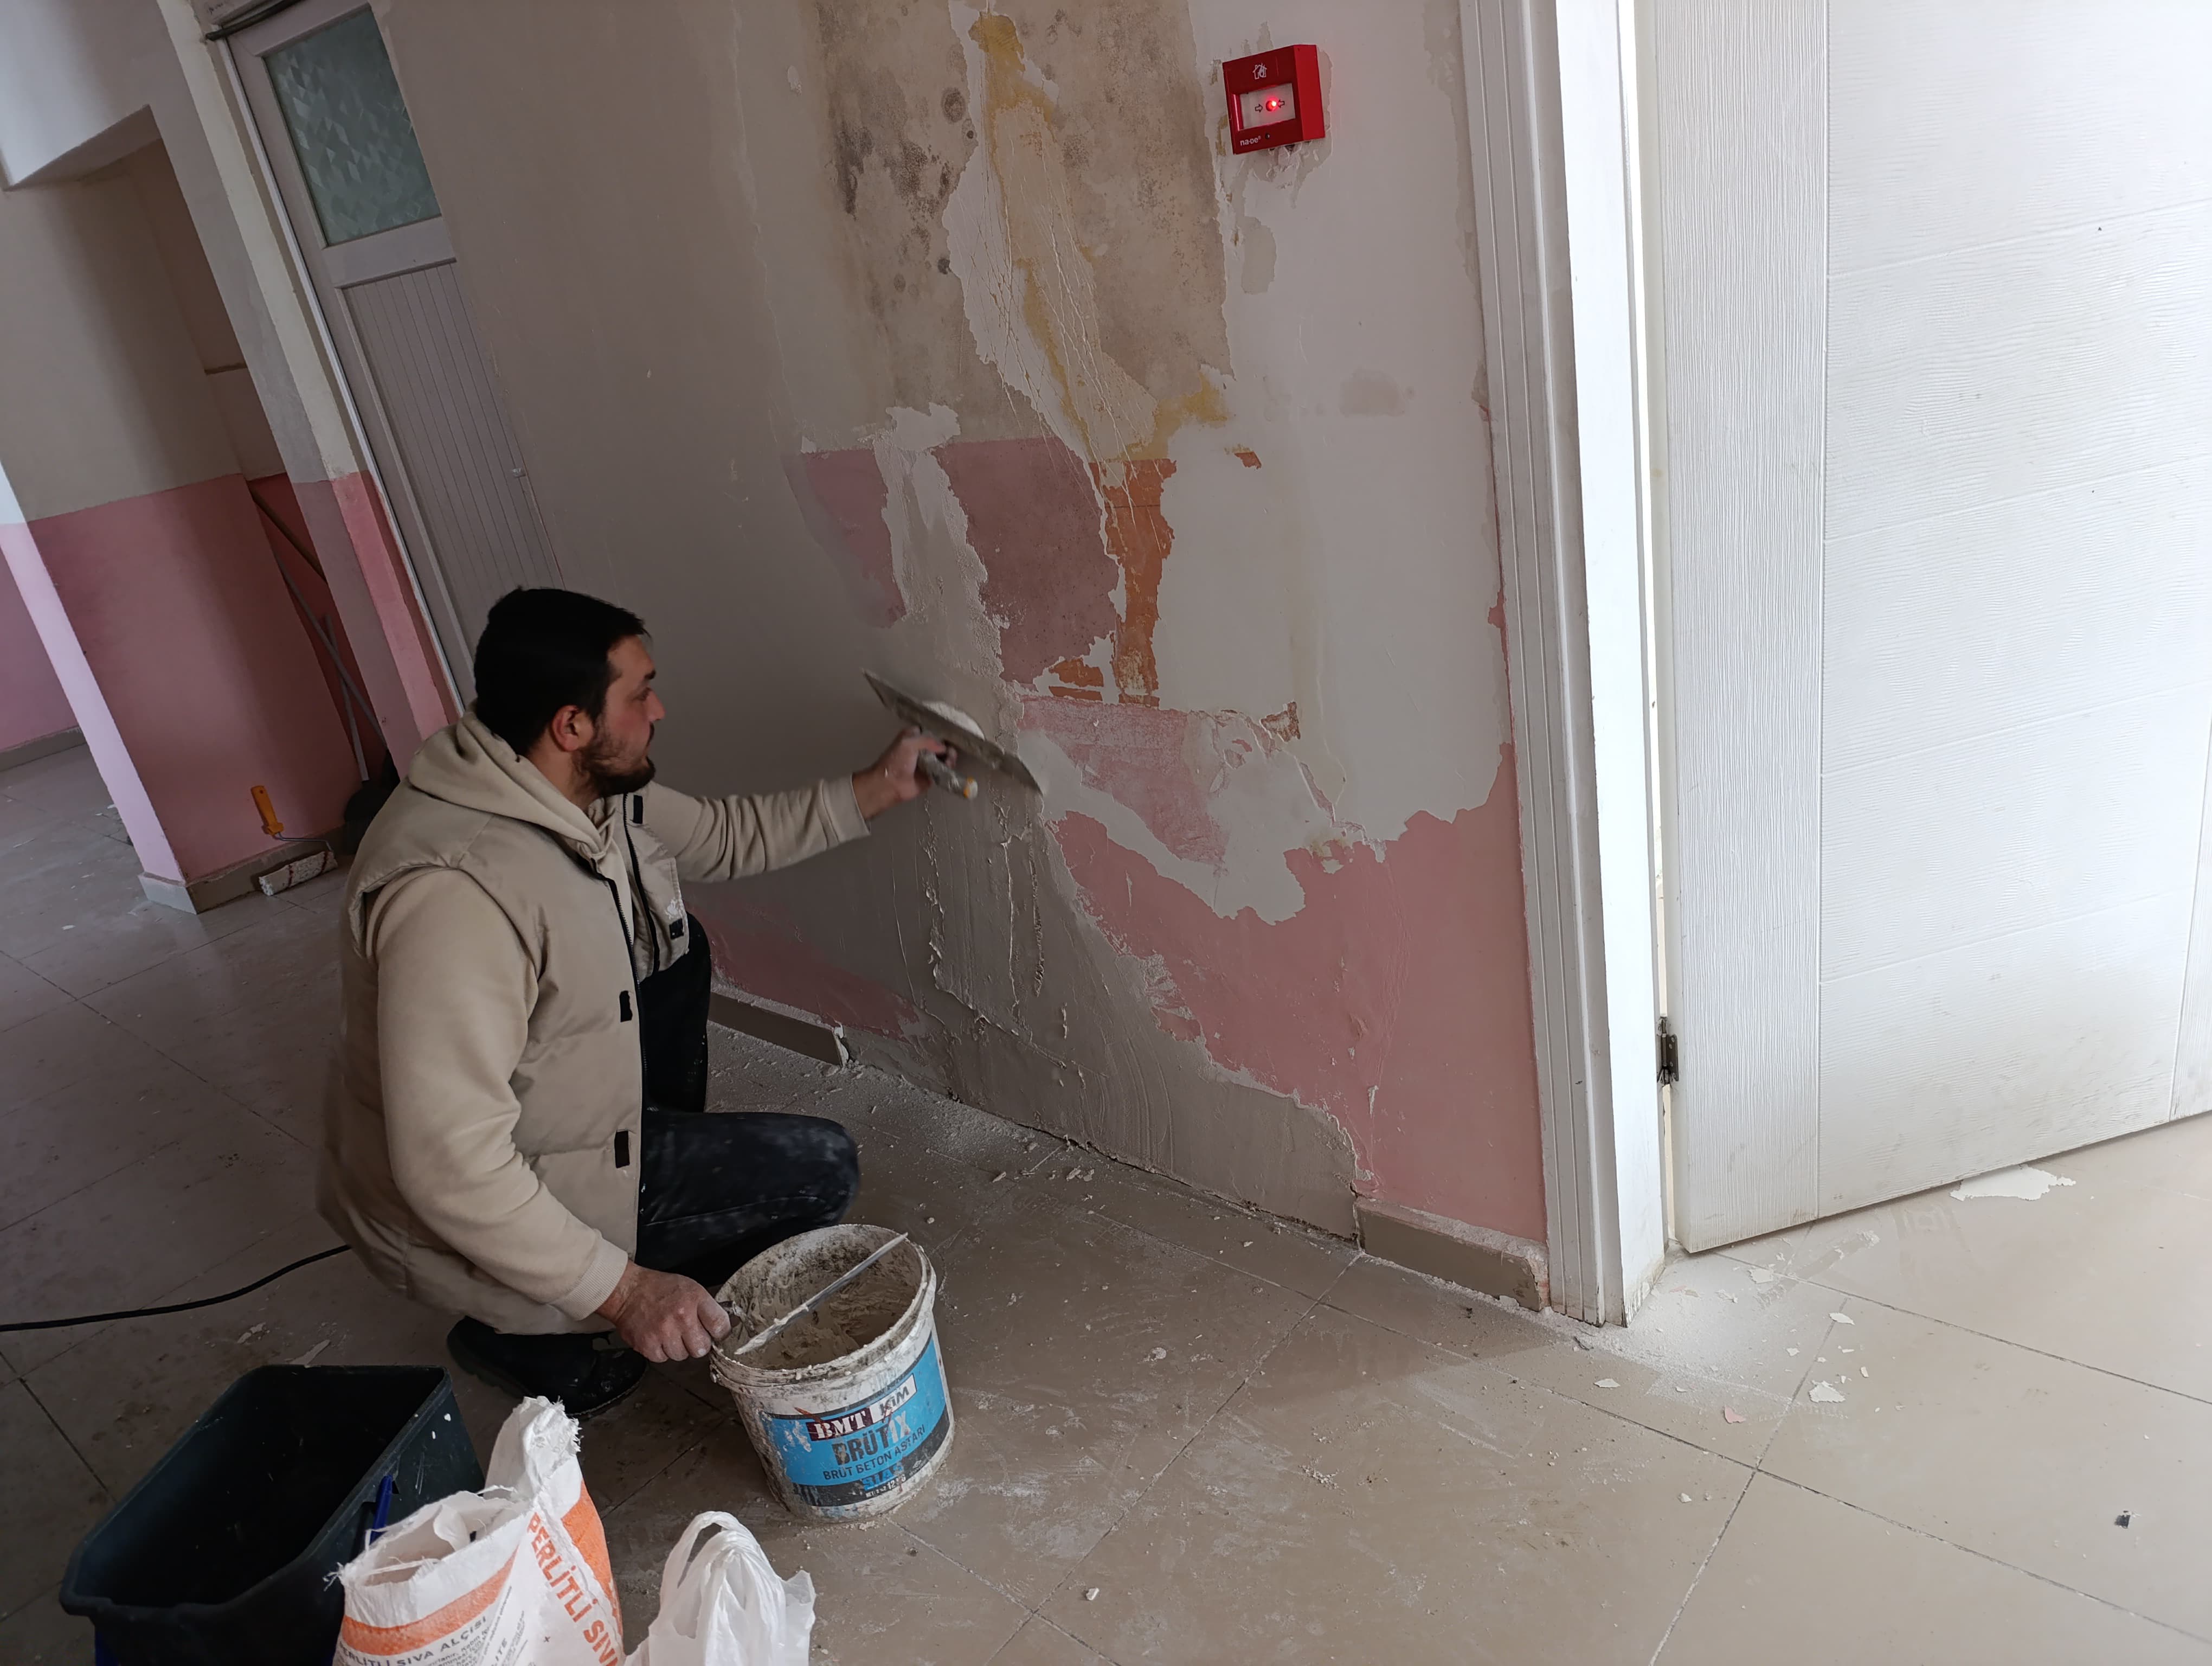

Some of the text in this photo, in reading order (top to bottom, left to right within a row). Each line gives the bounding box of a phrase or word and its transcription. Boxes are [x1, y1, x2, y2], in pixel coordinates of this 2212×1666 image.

[814, 1410, 866, 1439] BMT
[823, 1466, 852, 1480] BRÜT
[856, 1452, 892, 1474] BETON
[895, 1424, 925, 1457] ASTARI
